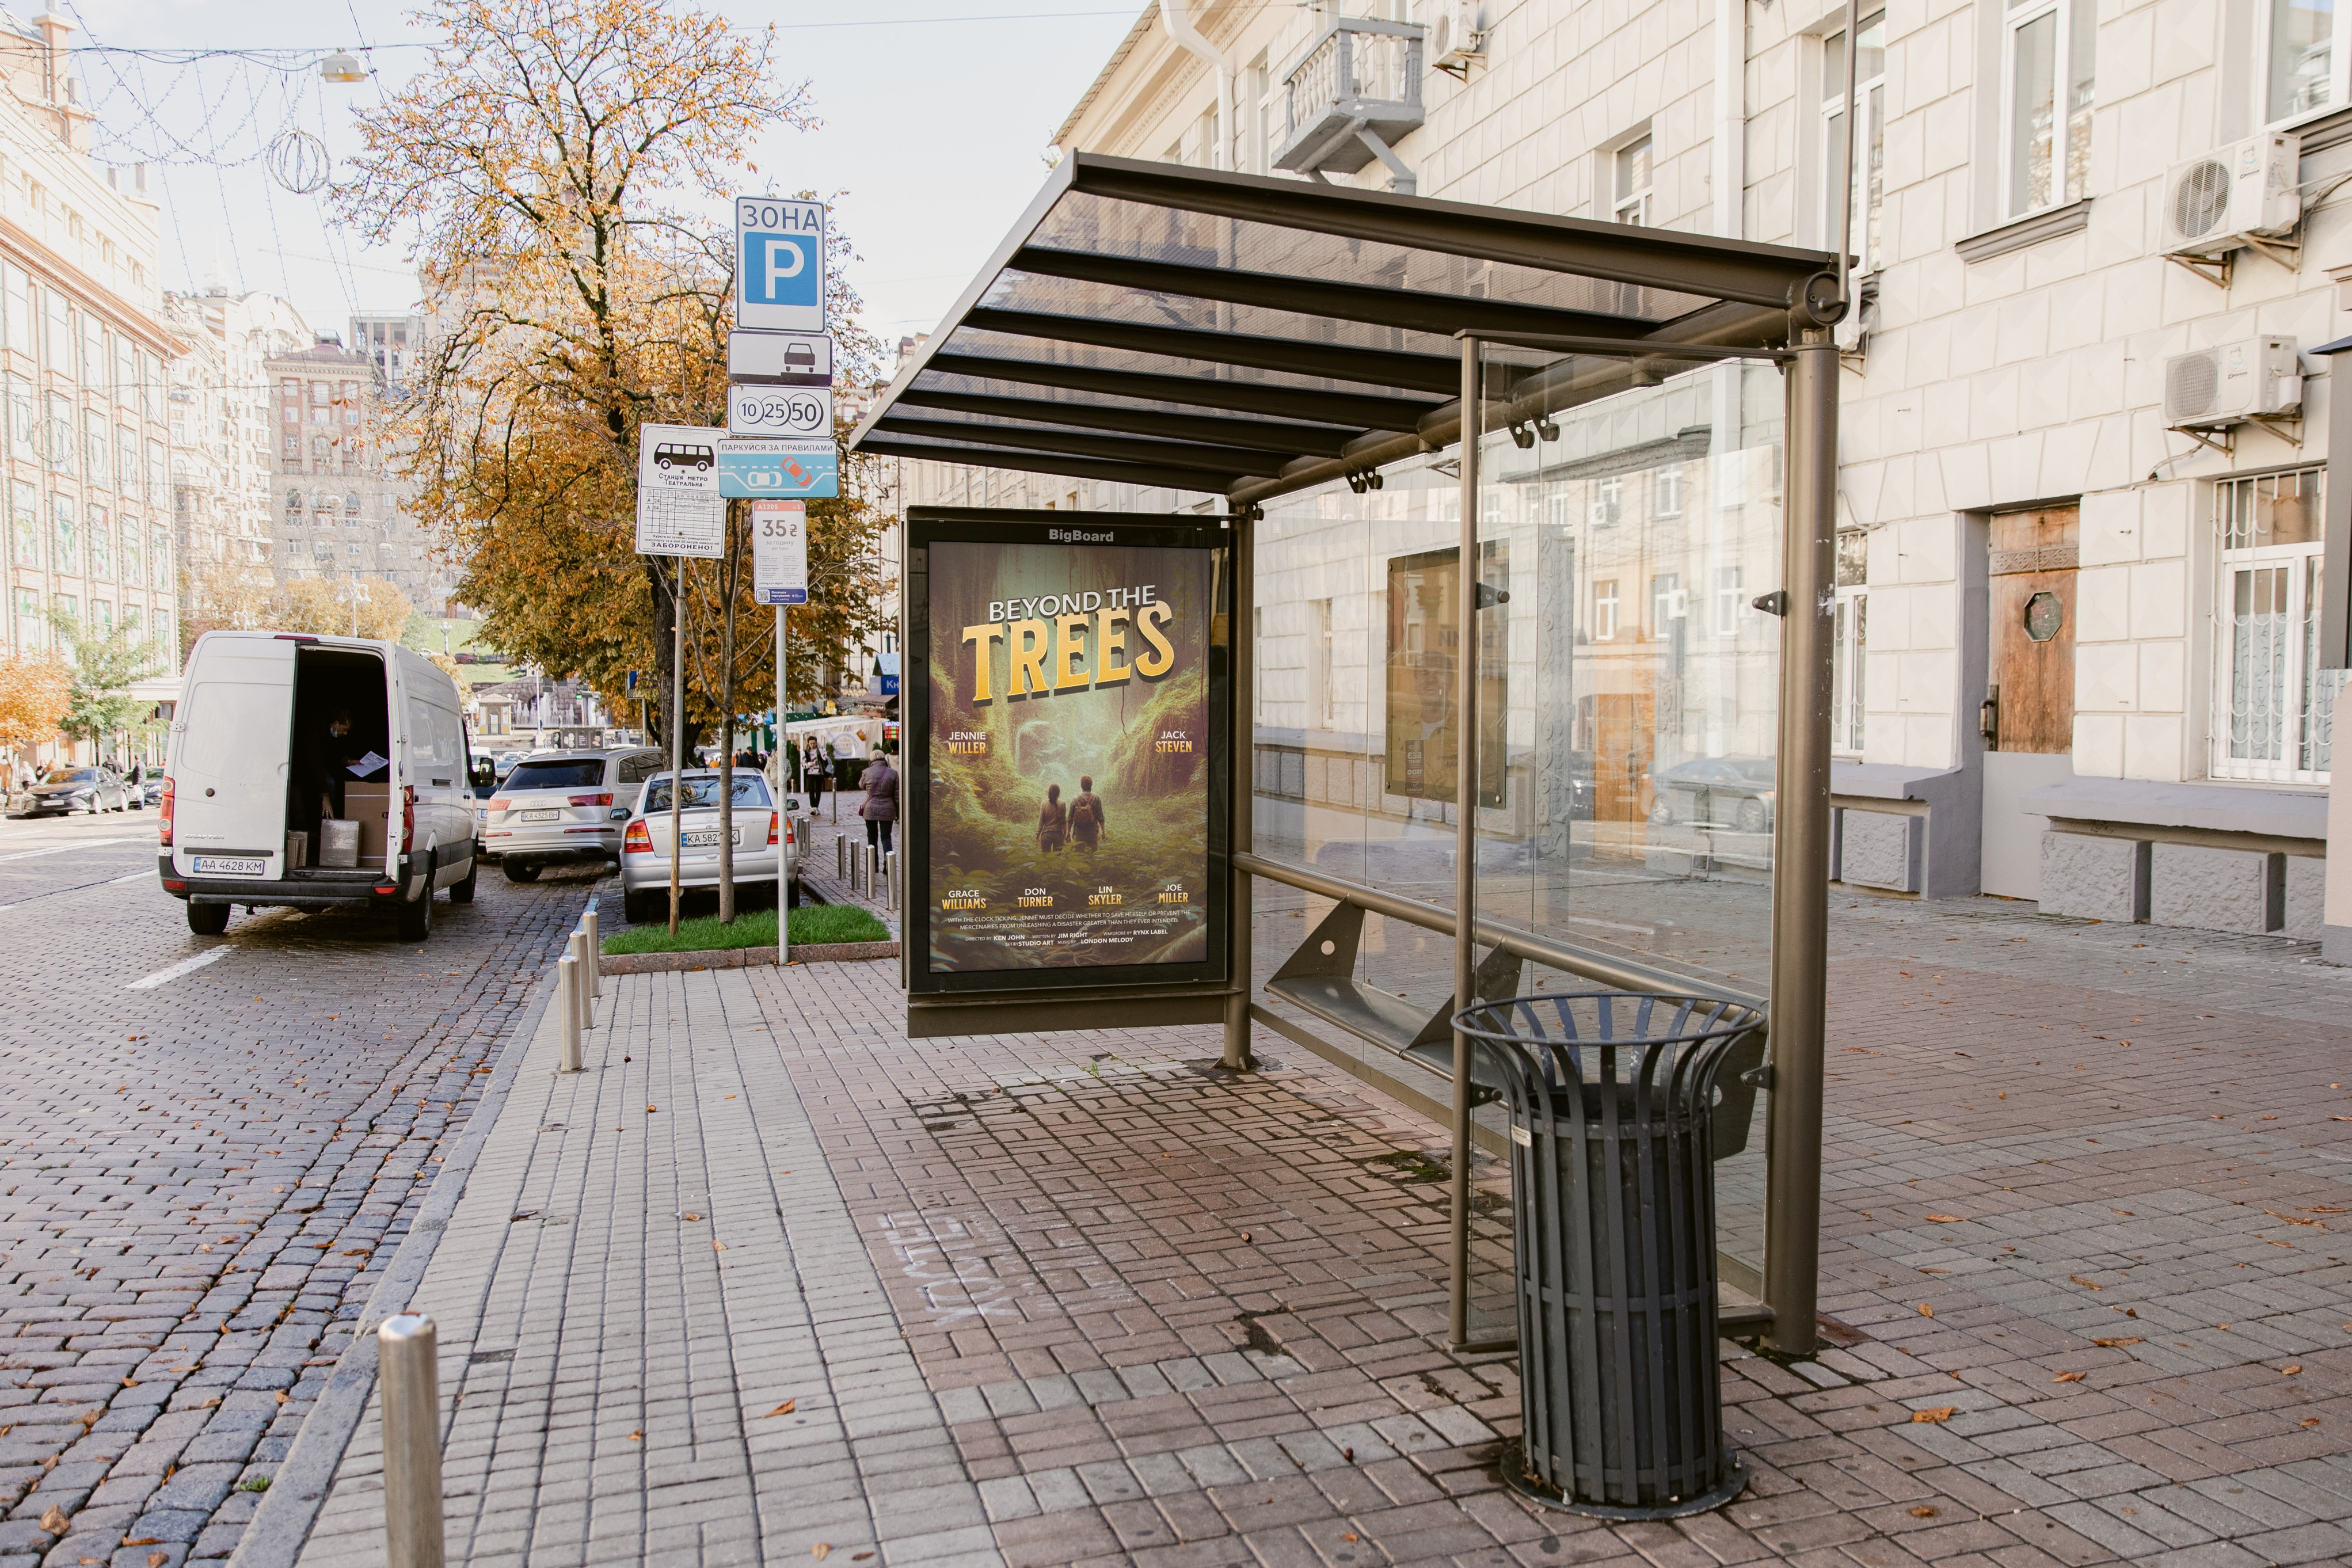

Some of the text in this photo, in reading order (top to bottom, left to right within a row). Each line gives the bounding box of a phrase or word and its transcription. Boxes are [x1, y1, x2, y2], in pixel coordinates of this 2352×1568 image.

[743, 205, 820, 232] ЗОНА
[766, 240, 805, 299] P
[741, 403, 817, 422] 10 25 50
[722, 443, 766, 451] ПАРКУЙСЯ
[763, 520, 787, 536] 35
[1049, 529, 1114, 543] BigBoard
[651, 542, 713, 550] ЗАБОРОНЕНО!
[989, 584, 1156, 623] BEYOND THE
[962, 600, 1175, 703] TREES
[949, 732, 986, 740] JENNIE
[1161, 731, 1186, 740] JACK
[949, 742, 986, 755] WILLER
[1155, 740, 1193, 753] STEVEN
[688, 834, 701, 843] KA
[702, 833, 720, 842] 582
[219, 861, 243, 870] 4628
[246, 862, 262, 871] KM
[949, 889, 980, 898] GRACE
[1025, 888, 1046, 896] DON
[1165, 884, 1182, 892] JOE
[1017, 896, 1053, 908] TURNER
[1088, 893, 1122, 906] SKYLER
[1158, 892, 1189, 904] MILLER
[942, 898, 987, 911] WILLIAMS
